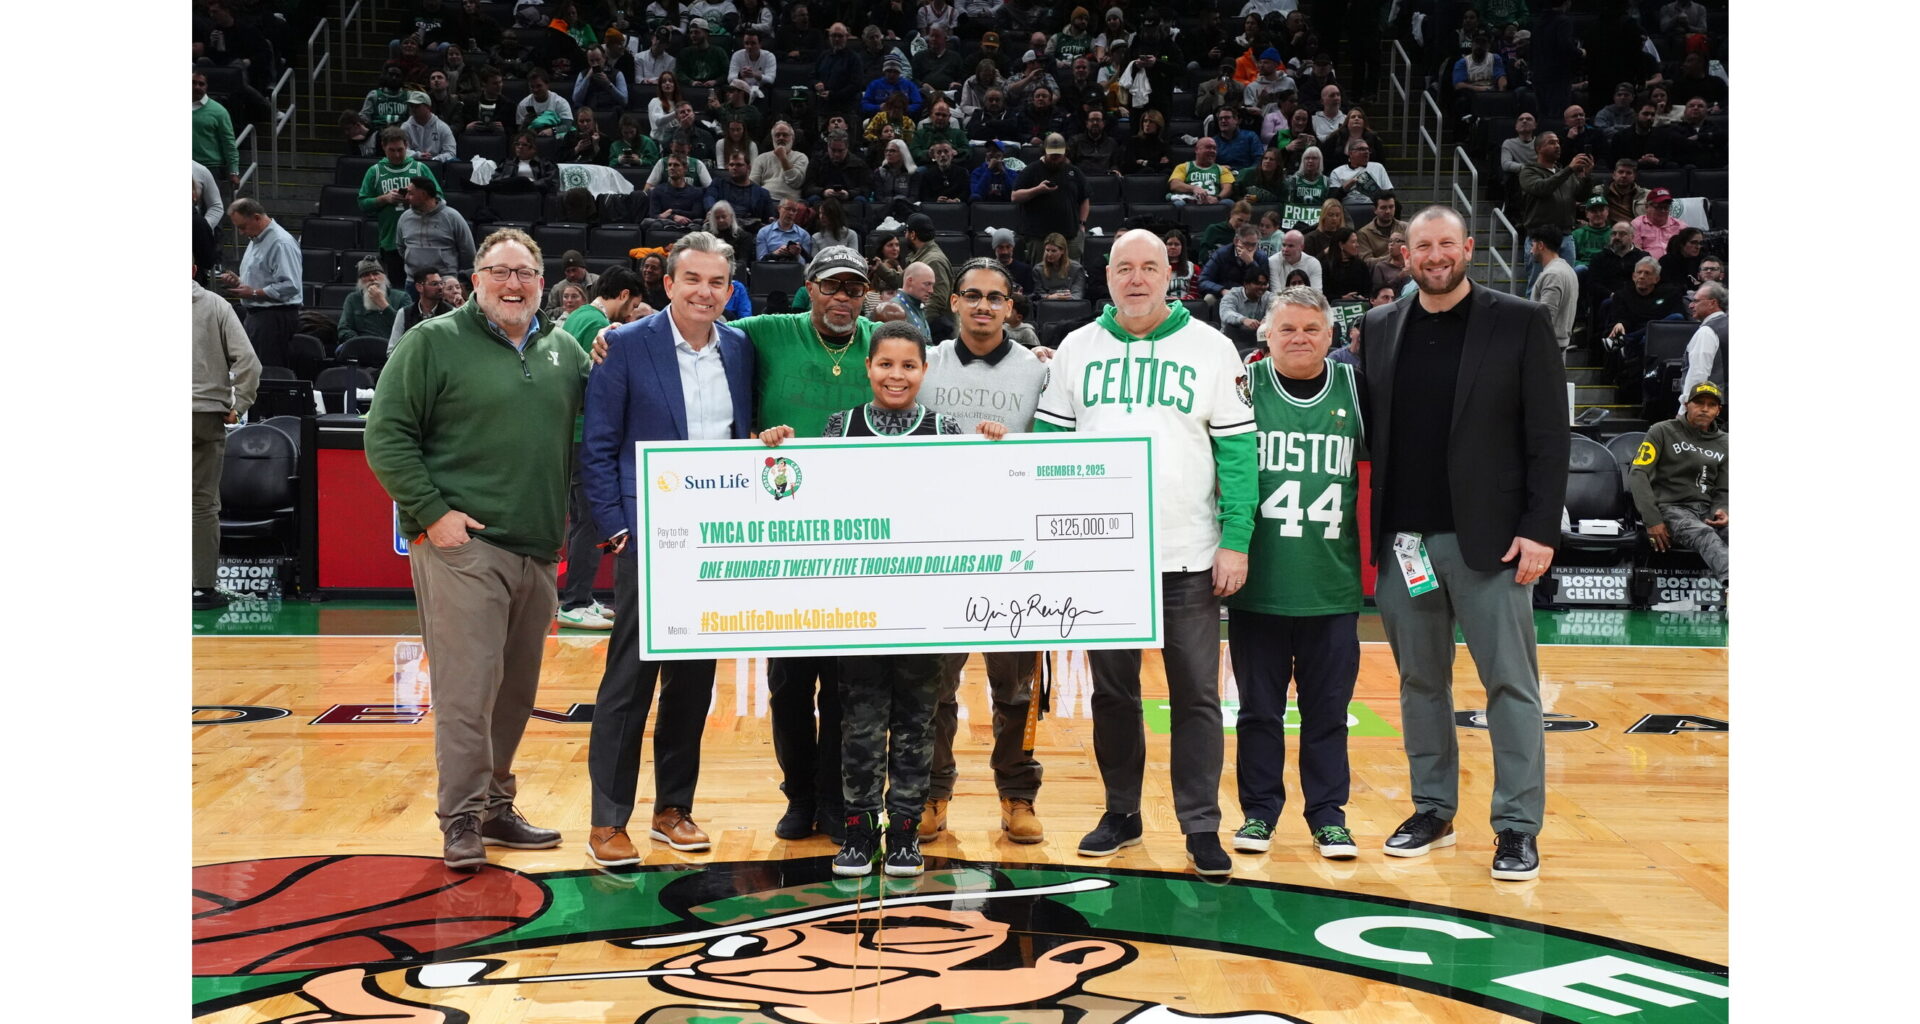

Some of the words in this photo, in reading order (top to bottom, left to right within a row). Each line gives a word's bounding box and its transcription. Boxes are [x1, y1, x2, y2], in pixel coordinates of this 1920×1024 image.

[1190, 171, 1217, 182] CELTICS
[381, 177, 411, 194] BOSTO
[1297, 187, 1322, 198] BOSTON
[1284, 204, 1322, 220] PRITC
[1083, 357, 1197, 414] CELTICS
[935, 386, 1024, 412] BOSTON
[1672, 441, 1725, 462] BOSTON
[1037, 465, 1076, 477] DECEMBER
[1077, 465, 1085, 477] 2,
[1086, 464, 1105, 476] 2025
[684, 475, 716, 490] Sun
[720, 473, 750, 489] Life
[1260, 480, 1343, 540] 44
[657, 527, 669, 539] Pay
[670, 528, 677, 537] to
[678, 527, 689, 537] the
[699, 521, 745, 544] YMCA
[748, 520, 765, 543] OF
[768, 519, 830, 542] GREATER
[834, 518, 891, 541] BOSTON
[659, 540, 678, 549] Order
[216, 566, 275, 578] OSTON
[699, 561, 724, 579] ONE
[724, 559, 781, 579] HUNDRED
[783, 558, 832, 577] TWENTY
[832, 558, 858, 576] FIVE
[860, 556, 922, 575] THOUSAND
[924, 555, 975, 573] DOLLARS
[977, 554, 1003, 572] AND
[216, 579, 270, 591] ELTICS
[1561, 575, 1627, 588] BOSTON
[1656, 577, 1723, 589] BOSTON
[1566, 588, 1625, 600] CELTICS
[1660, 589, 1721, 601] CELTICS
[701, 607, 877, 632] #SunLifeDunk4Diabetes
[667, 626, 688, 635] Memo
